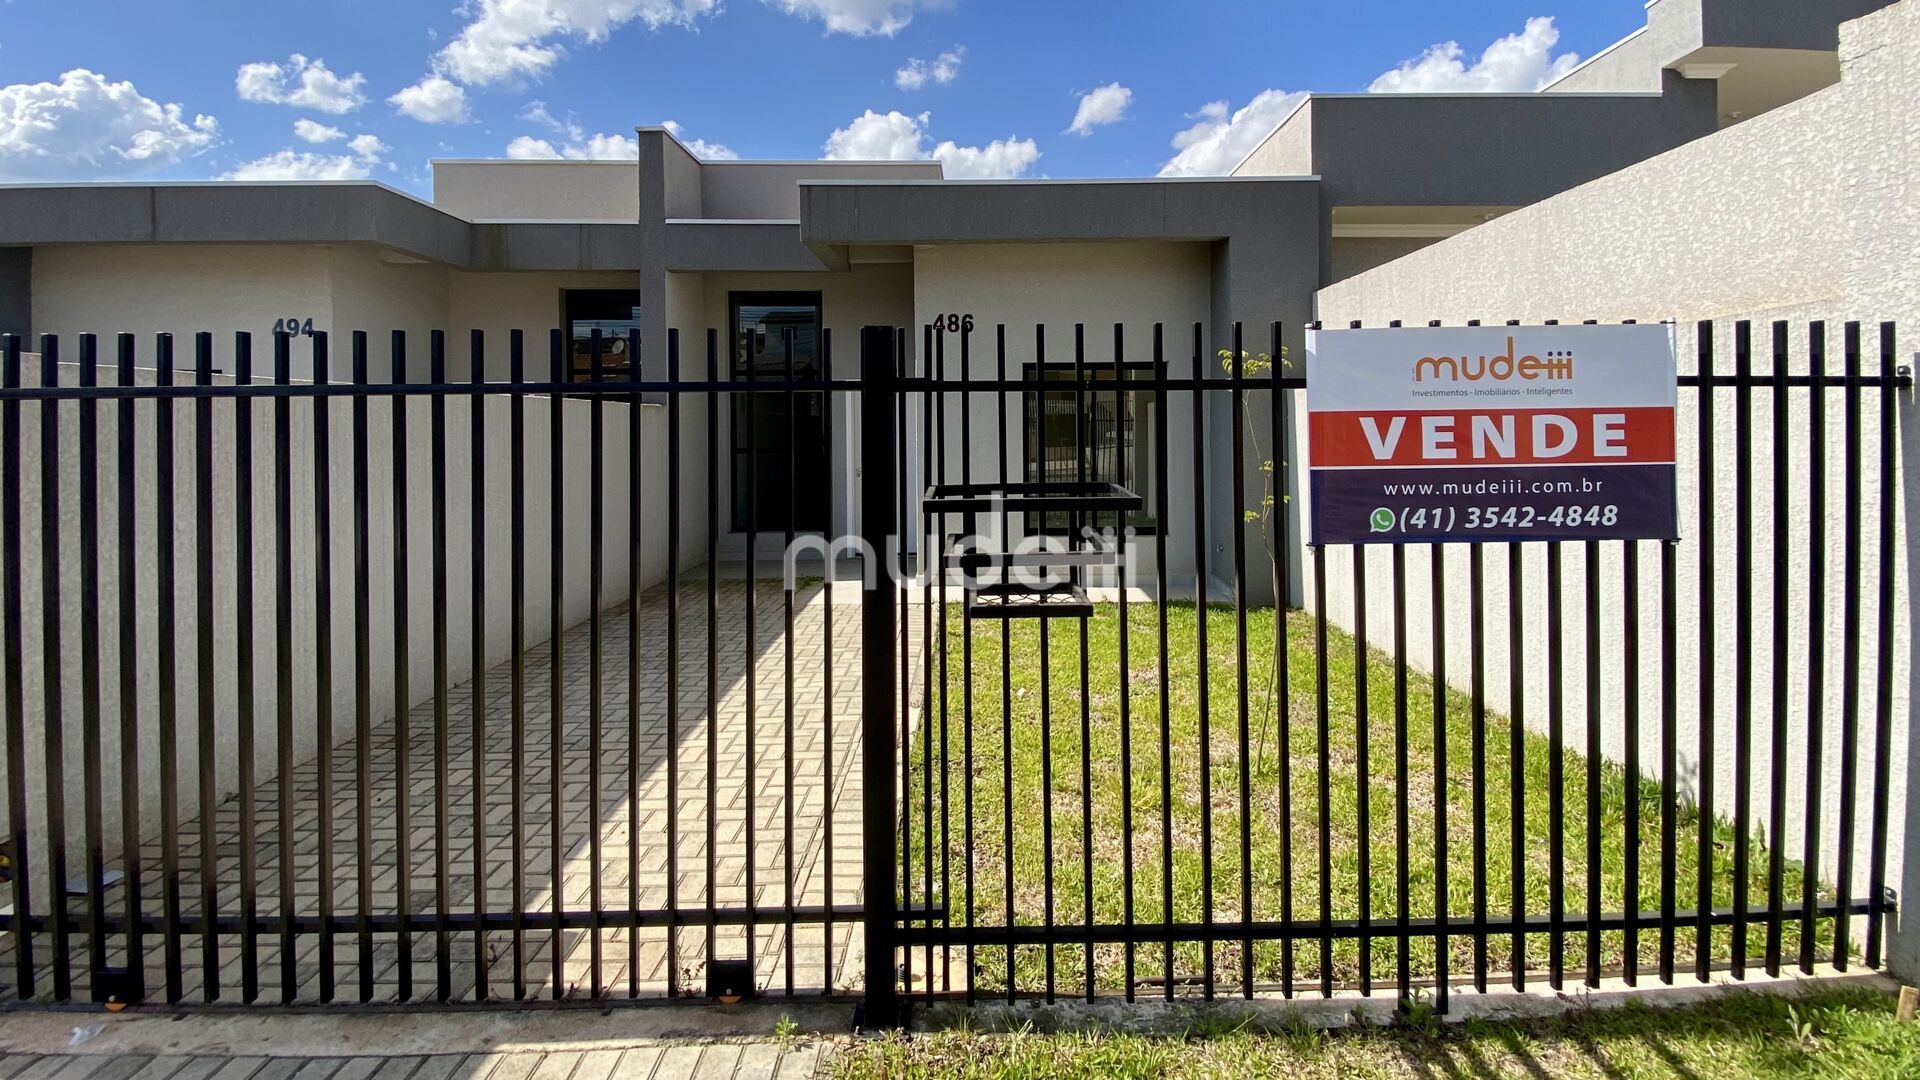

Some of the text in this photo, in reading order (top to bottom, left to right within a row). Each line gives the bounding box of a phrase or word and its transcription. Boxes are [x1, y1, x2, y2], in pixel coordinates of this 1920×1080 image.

[272, 318, 314, 337] 494
[933, 314, 974, 333] 486
[1415, 336, 1573, 382] mudeiii
[1412, 389, 1468, 397] Investimentos
[1474, 388, 1521, 396] Imobiliários
[1526, 387, 1573, 396] Inteligentes
[1358, 413, 1628, 460] VENDE
[1383, 478, 1603, 495] www.mudeiii.com.br
[1400, 505, 1618, 532] (41) 3542-4848
